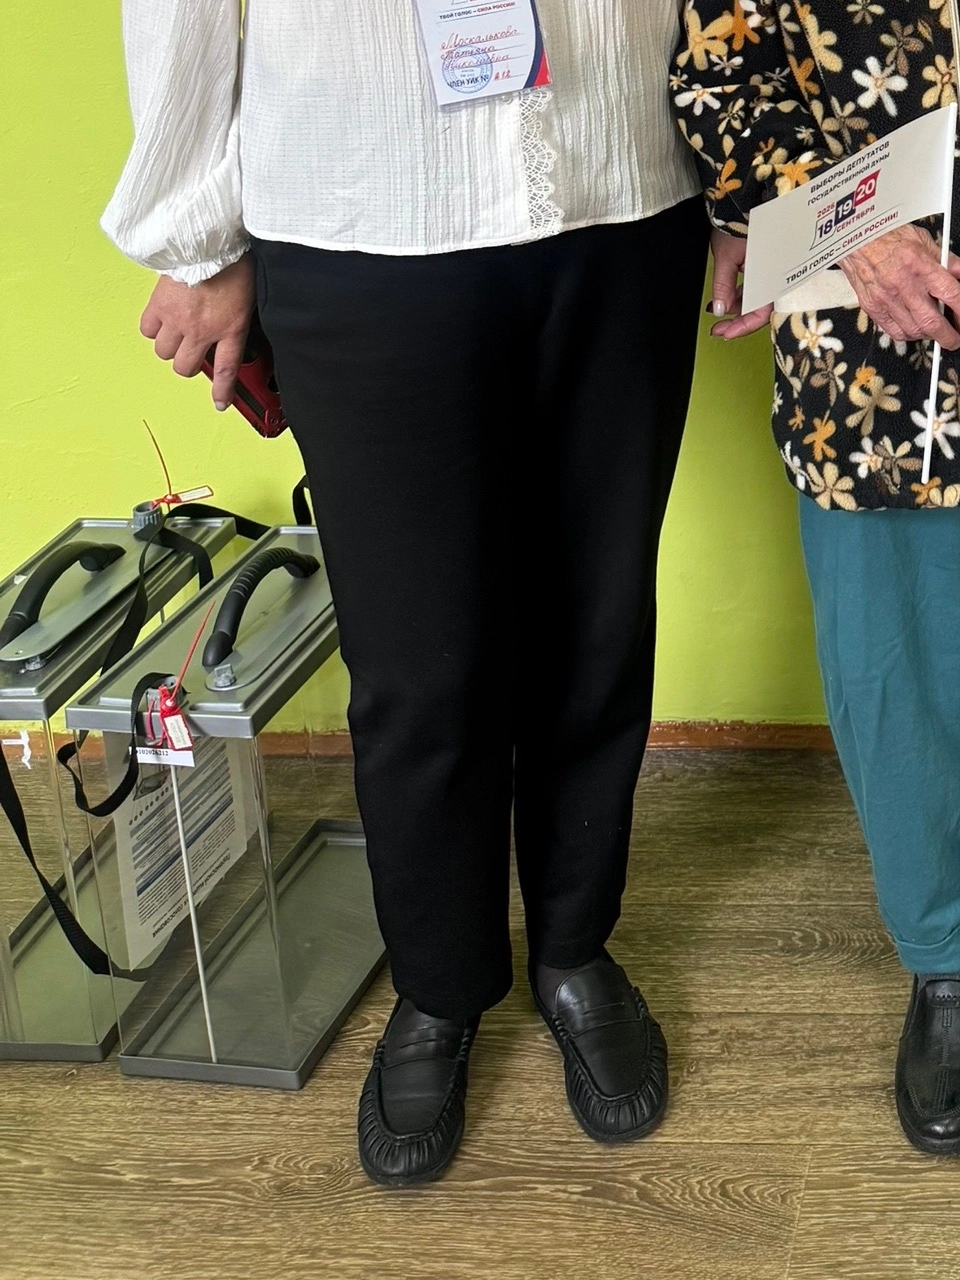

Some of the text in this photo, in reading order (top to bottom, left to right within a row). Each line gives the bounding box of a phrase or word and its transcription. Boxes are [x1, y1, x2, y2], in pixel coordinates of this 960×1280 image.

[454, 9, 472, 18] ГОЛОС
[447, 79, 465, 88] ЧЛЕН
[466, 77, 480, 85] УИК
[808, 152, 891, 207] ГОСУДАРСТВЕННОЙ ДУМЫ
[810, 140, 890, 194] ВЫБОРЫ ДЕПУТАТОВ
[817, 178, 876, 239] 18 19 20
[817, 201, 835, 218] 2026
[836, 204, 876, 233] СЕНТЯБРЯ
[785, 265, 808, 284] ТВОЙ
[809, 248, 835, 271] ГОЛОС
[842, 232, 863, 248] СИЛА
[864, 211, 899, 236] РОССИИ!
